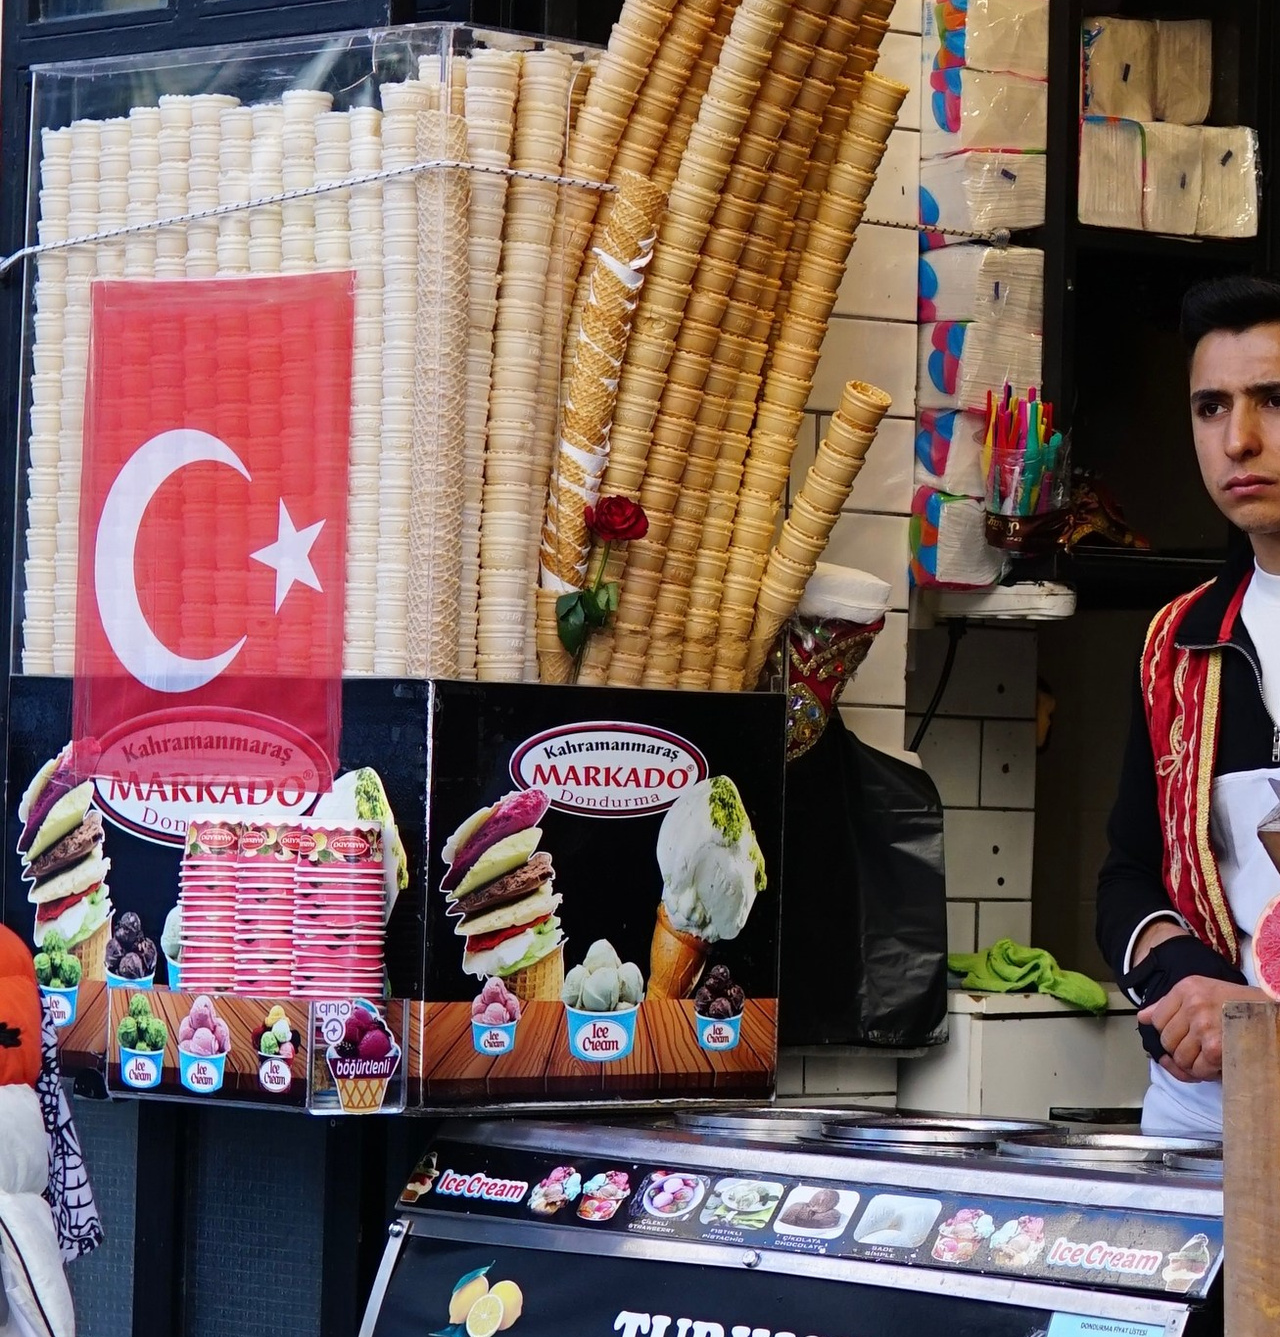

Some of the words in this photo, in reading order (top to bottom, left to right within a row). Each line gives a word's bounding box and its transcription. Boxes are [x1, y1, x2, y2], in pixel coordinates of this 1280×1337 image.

[121, 734, 294, 766] Kahramanmaraş
[543, 740, 680, 763] Kahramanmaraş
[532, 764, 689, 789] MARKADO
[109, 770, 306, 807] MARKADO
[560, 789, 661, 808] Dondurma
[319, 1003, 350, 1016] Club
[489, 1030, 500, 1041] Ice
[592, 1023, 609, 1039] Ice
[712, 1024, 723, 1036] Ice
[483, 1038, 505, 1048] Cream
[582, 1037, 619, 1052] Cream
[706, 1033, 730, 1044] Cream
[135, 1058, 146, 1072] Ice
[196, 1062, 208, 1075] Ice
[269, 1062, 280, 1075] Ice
[336, 1058, 391, 1079] böğürtlenli
[128, 1069, 152, 1082] Cream
[190, 1073, 214, 1086] Cream
[263, 1073, 286, 1086] Cream
[1080, 1322, 1113, 1332] DONDURMA
